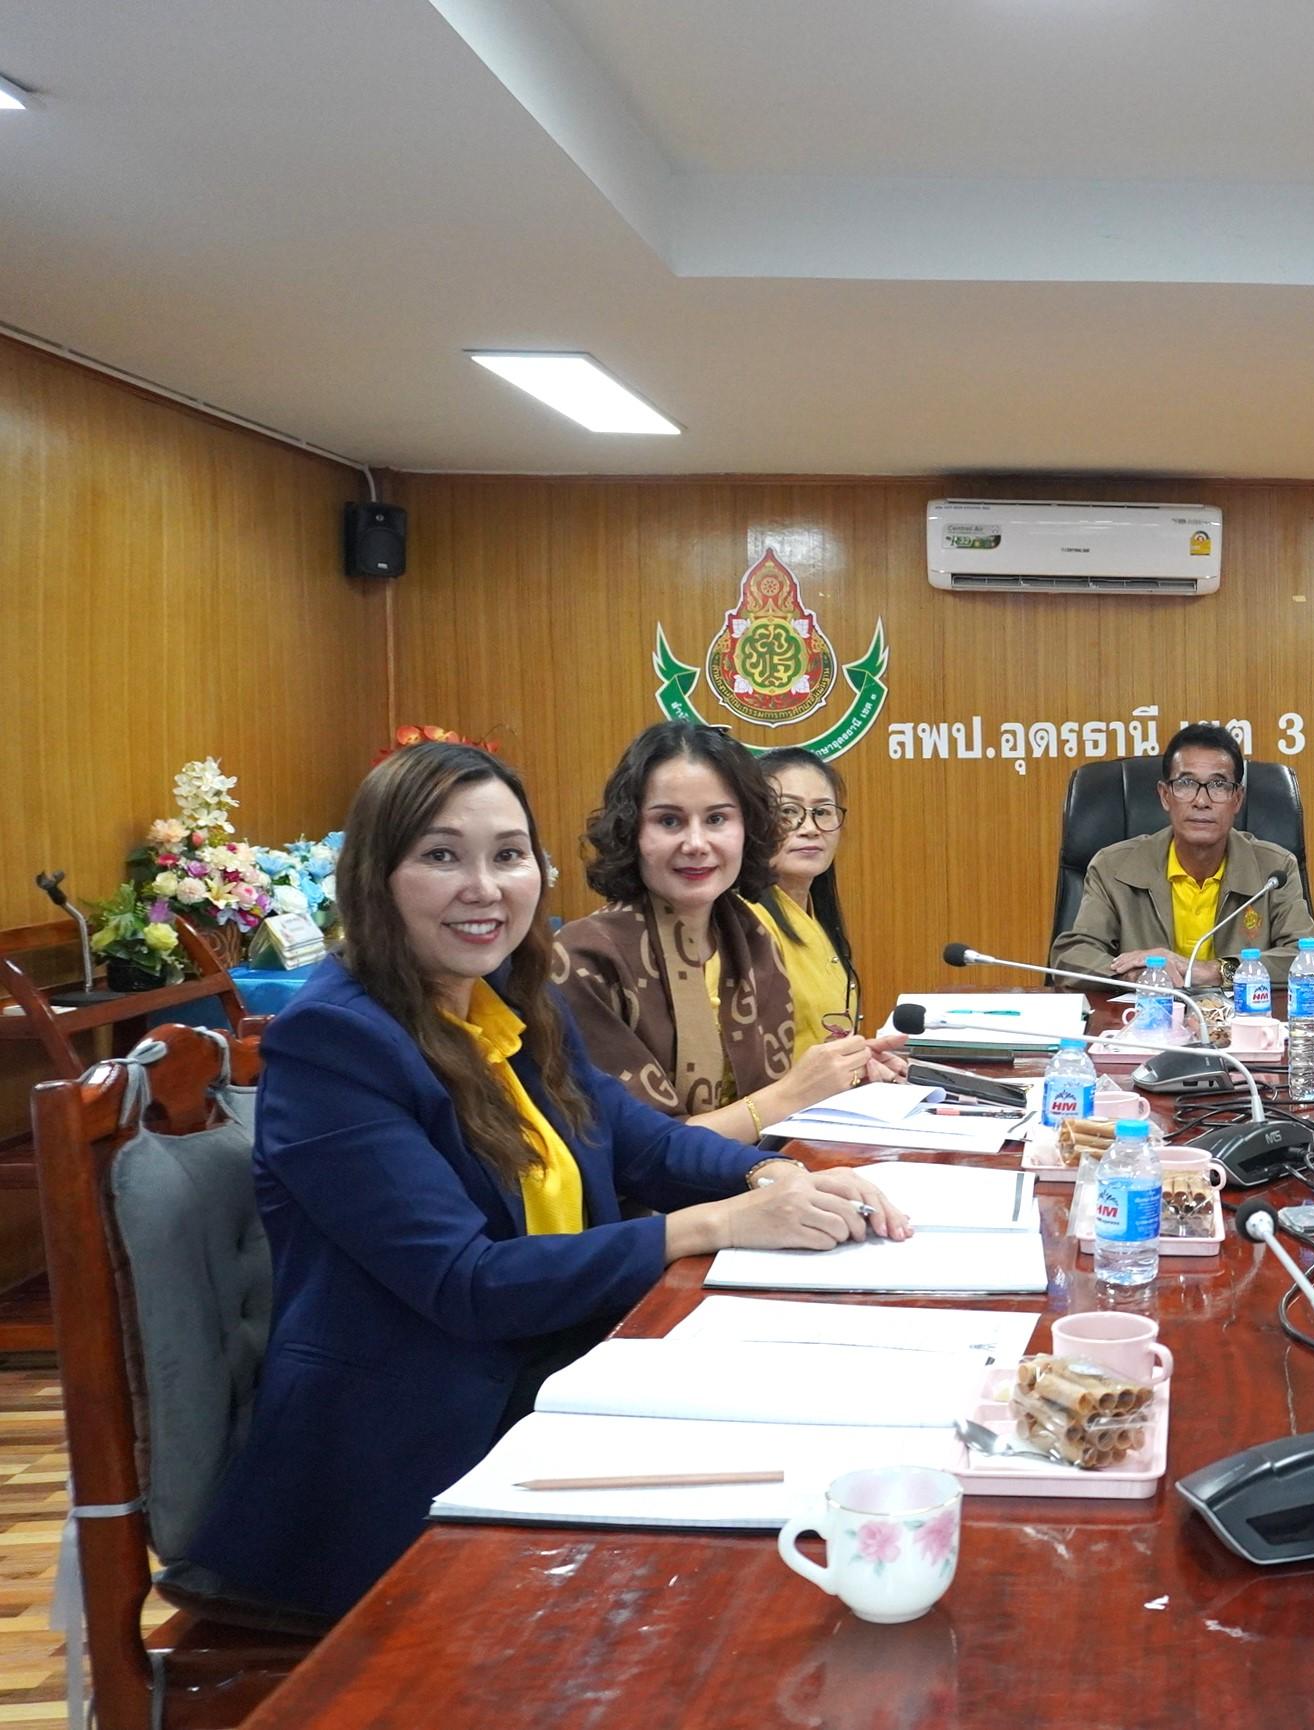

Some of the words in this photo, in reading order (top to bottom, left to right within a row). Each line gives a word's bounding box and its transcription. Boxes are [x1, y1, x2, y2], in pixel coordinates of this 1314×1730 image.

[888, 705, 1160, 775] สพป.อุดรธานี
[1278, 712, 1306, 756] 3
[1052, 1102, 1077, 1111] HM
